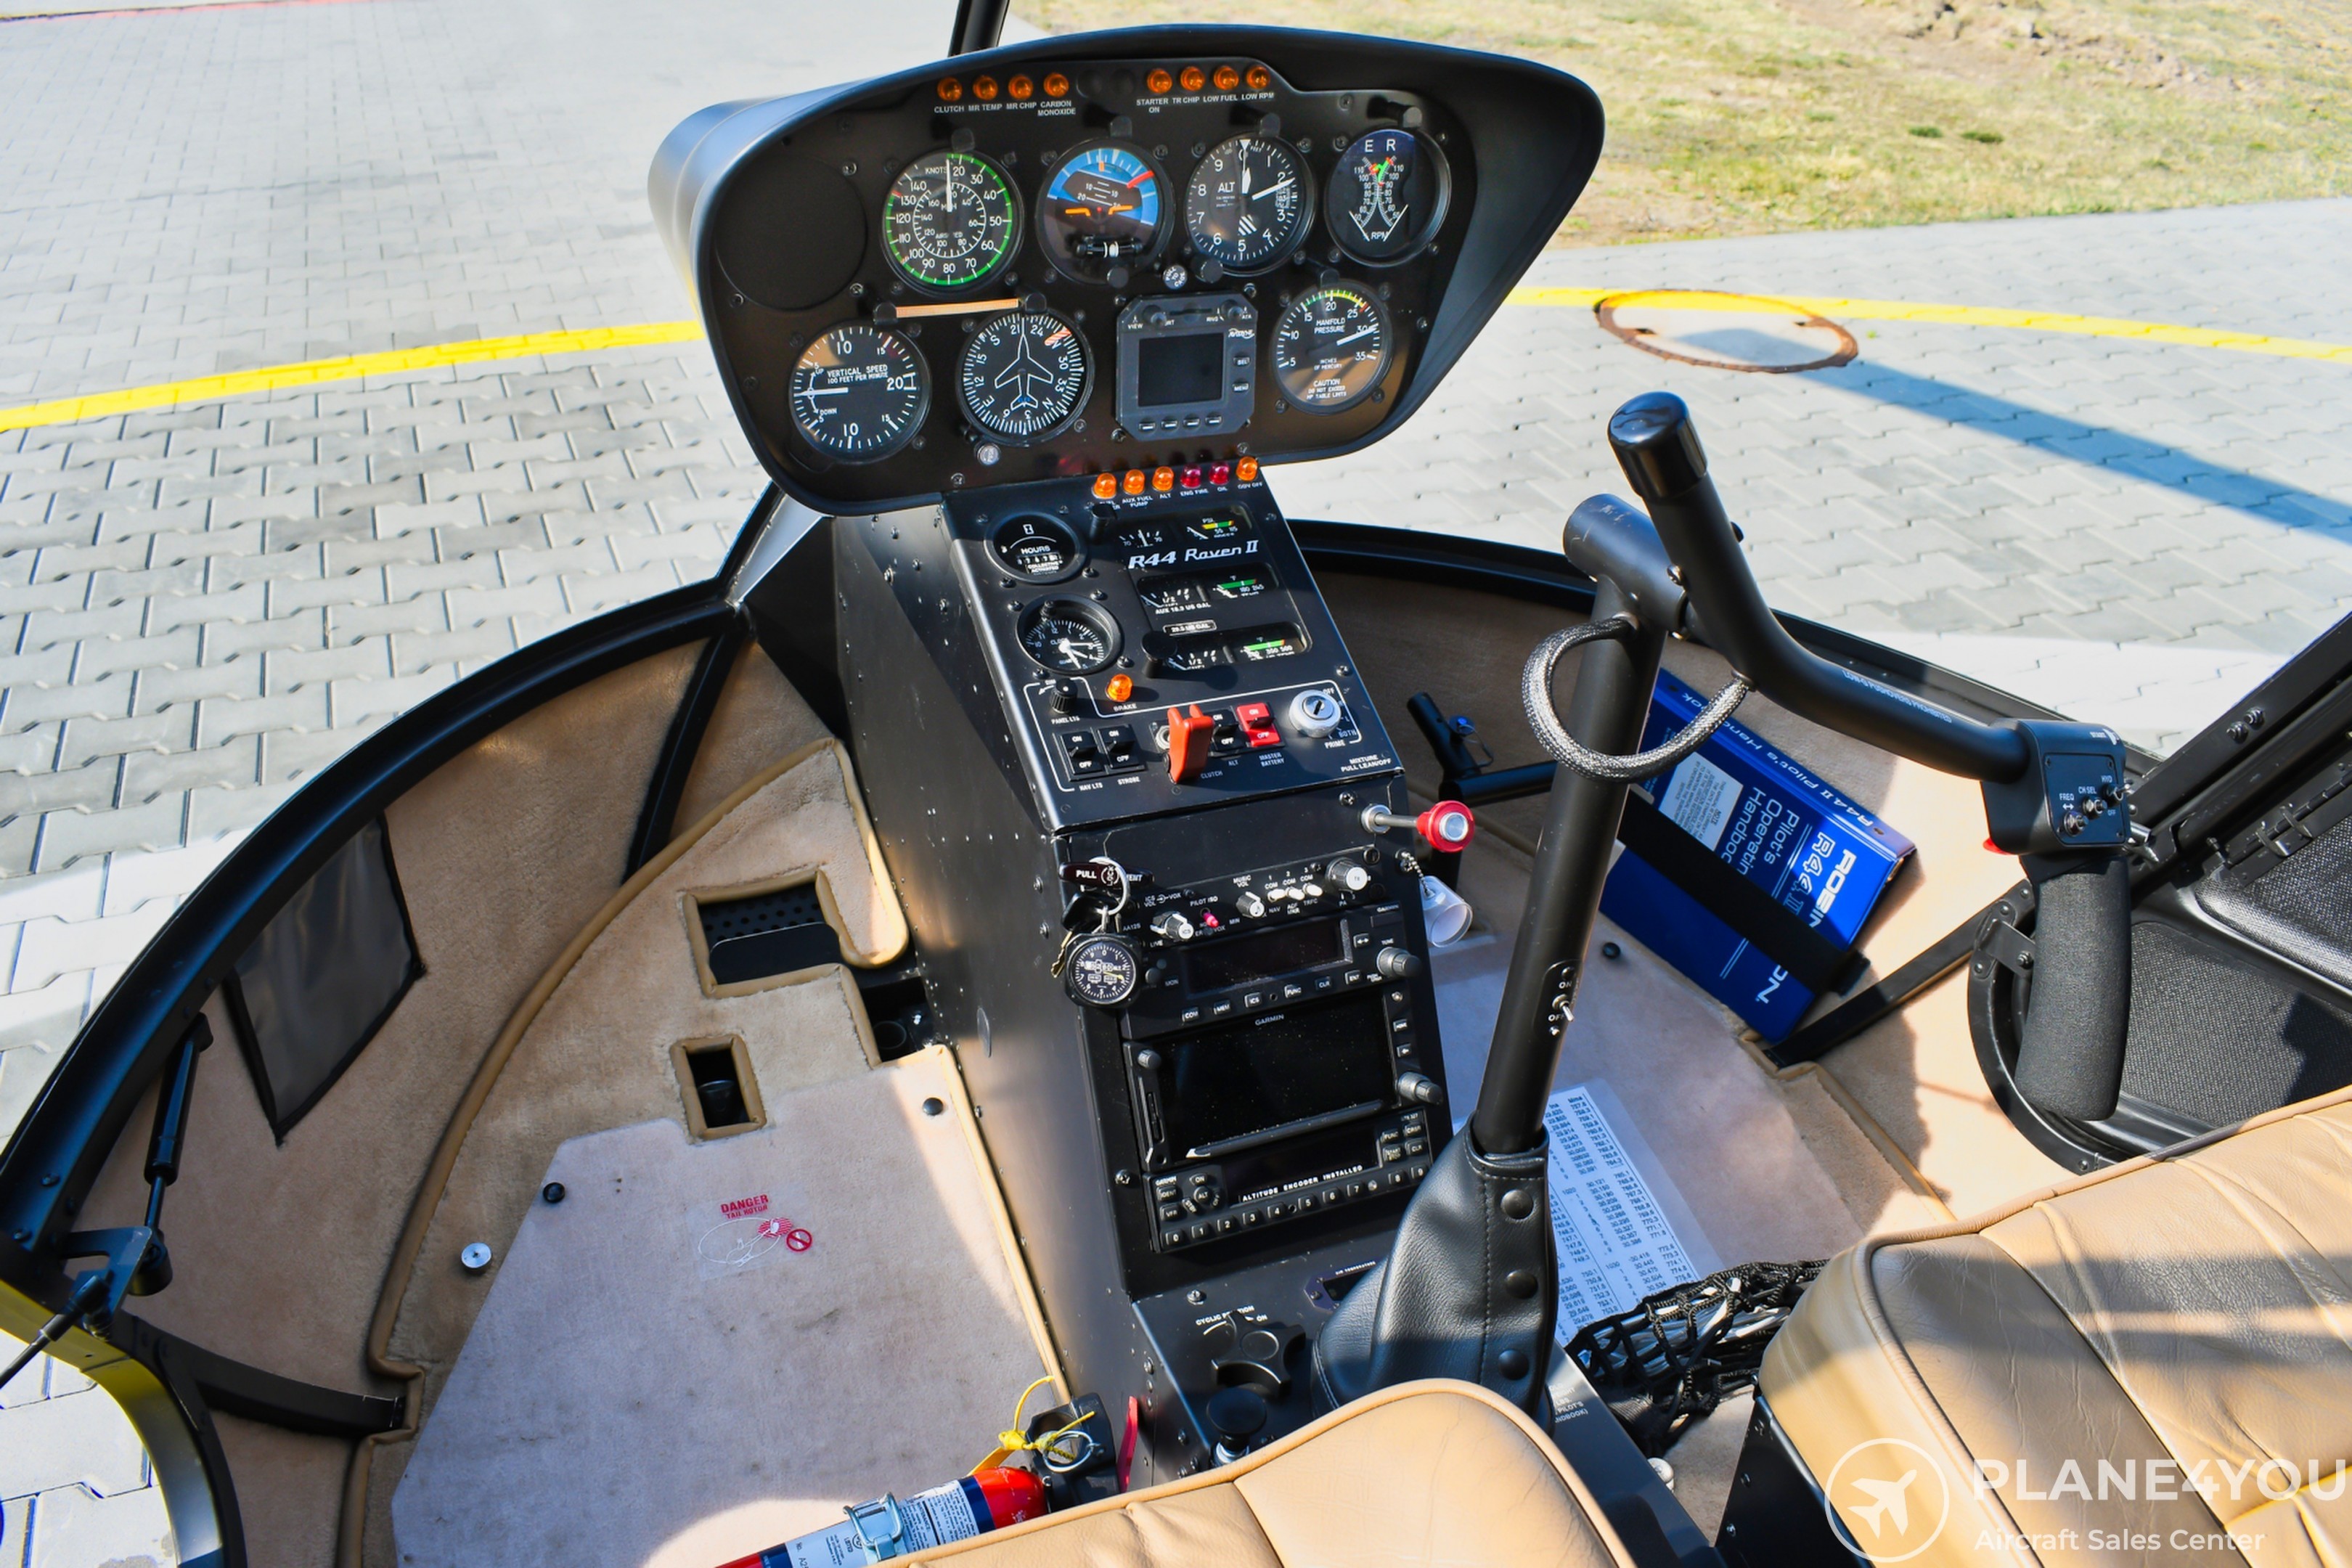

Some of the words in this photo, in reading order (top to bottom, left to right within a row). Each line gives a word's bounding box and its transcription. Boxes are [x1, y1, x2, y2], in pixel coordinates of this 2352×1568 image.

[1220, 94, 1238, 102] FUEL
[934, 105, 965, 113] CLUTCH
[1037, 108, 1077, 117] MONOXIDE
[1365, 139, 1374, 152] E
[1386, 139, 1396, 152] R
[953, 166, 965, 176] 20
[971, 174, 984, 184] 30
[910, 181, 927, 191] 140
[1217, 181, 1236, 192] ALT
[901, 196, 917, 205] 130
[984, 191, 997, 200] 40
[896, 213, 911, 224] 120
[989, 216, 1002, 226] 50
[981, 240, 995, 250] 60
[909, 249, 925, 258] 100
[922, 258, 936, 269] 90
[965, 258, 977, 268] 70
[943, 263, 956, 274] 80
[1316, 317, 1346, 326] MANIFOLD
[1010, 324, 1020, 335] 21
[1030, 324, 1045, 337] 24
[1314, 325, 1346, 334] PRESSURE
[827, 367, 862, 379] VERTICAL
[866, 364, 888, 373] SPEED
[886, 377, 904, 391] 20
[1313, 378, 1341, 388] CAUTION
[982, 395, 995, 408] E
[1021, 545, 1051, 555] HOURS
[1128, 550, 1177, 569] R44
[1185, 547, 1242, 562] Raven
[1245, 539, 1259, 553] II
[1842, 669, 1869, 687] LOW-G
[1911, 700, 1953, 724] PROHIBITED
[1113, 703, 1138, 712] BRAKE
[1257, 731, 1270, 740] OFF
[1339, 729, 1357, 738] BOTH
[1221, 737, 1235, 746] OFF
[1324, 740, 1347, 749] PRIME
[1259, 752, 1283, 761] MASTER
[1349, 754, 1379, 764] MIXTURE
[1079, 761, 1093, 769] OFF
[1261, 758, 1285, 767] BATTERY
[1341, 764, 1359, 772] PULL
[1359, 759, 1392, 770] LEAN/OFF
[1200, 770, 1223, 780] CLUTCH
[1766, 751, 1819, 790] Pilot's
[1117, 777, 1141, 785] STROBE
[1835, 797, 1874, 828] R44
[1737, 799, 1783, 875] Operatin
[1764, 809, 1800, 865] Pilot's
[1791, 832, 1837, 895] R44
[1076, 870, 1097, 879] PULL
[1233, 875, 1252, 884] MUSIC
[1150, 939, 1164, 948] LIVE
[1559, 981, 1573, 989] ON
[1255, 1015, 1284, 1026] GARMIN
[1242, 1187, 1278, 1202] ALTITUDE
[1283, 1176, 1319, 1191] ENCODER
[1323, 1164, 1363, 1181] INSTALLED
[720, 1194, 769, 1214] DANGER
[727, 1210, 742, 1220] TAIL
[1196, 1315, 1222, 1326] CYCLIC
[1222, 1305, 1254, 1319] FTION
